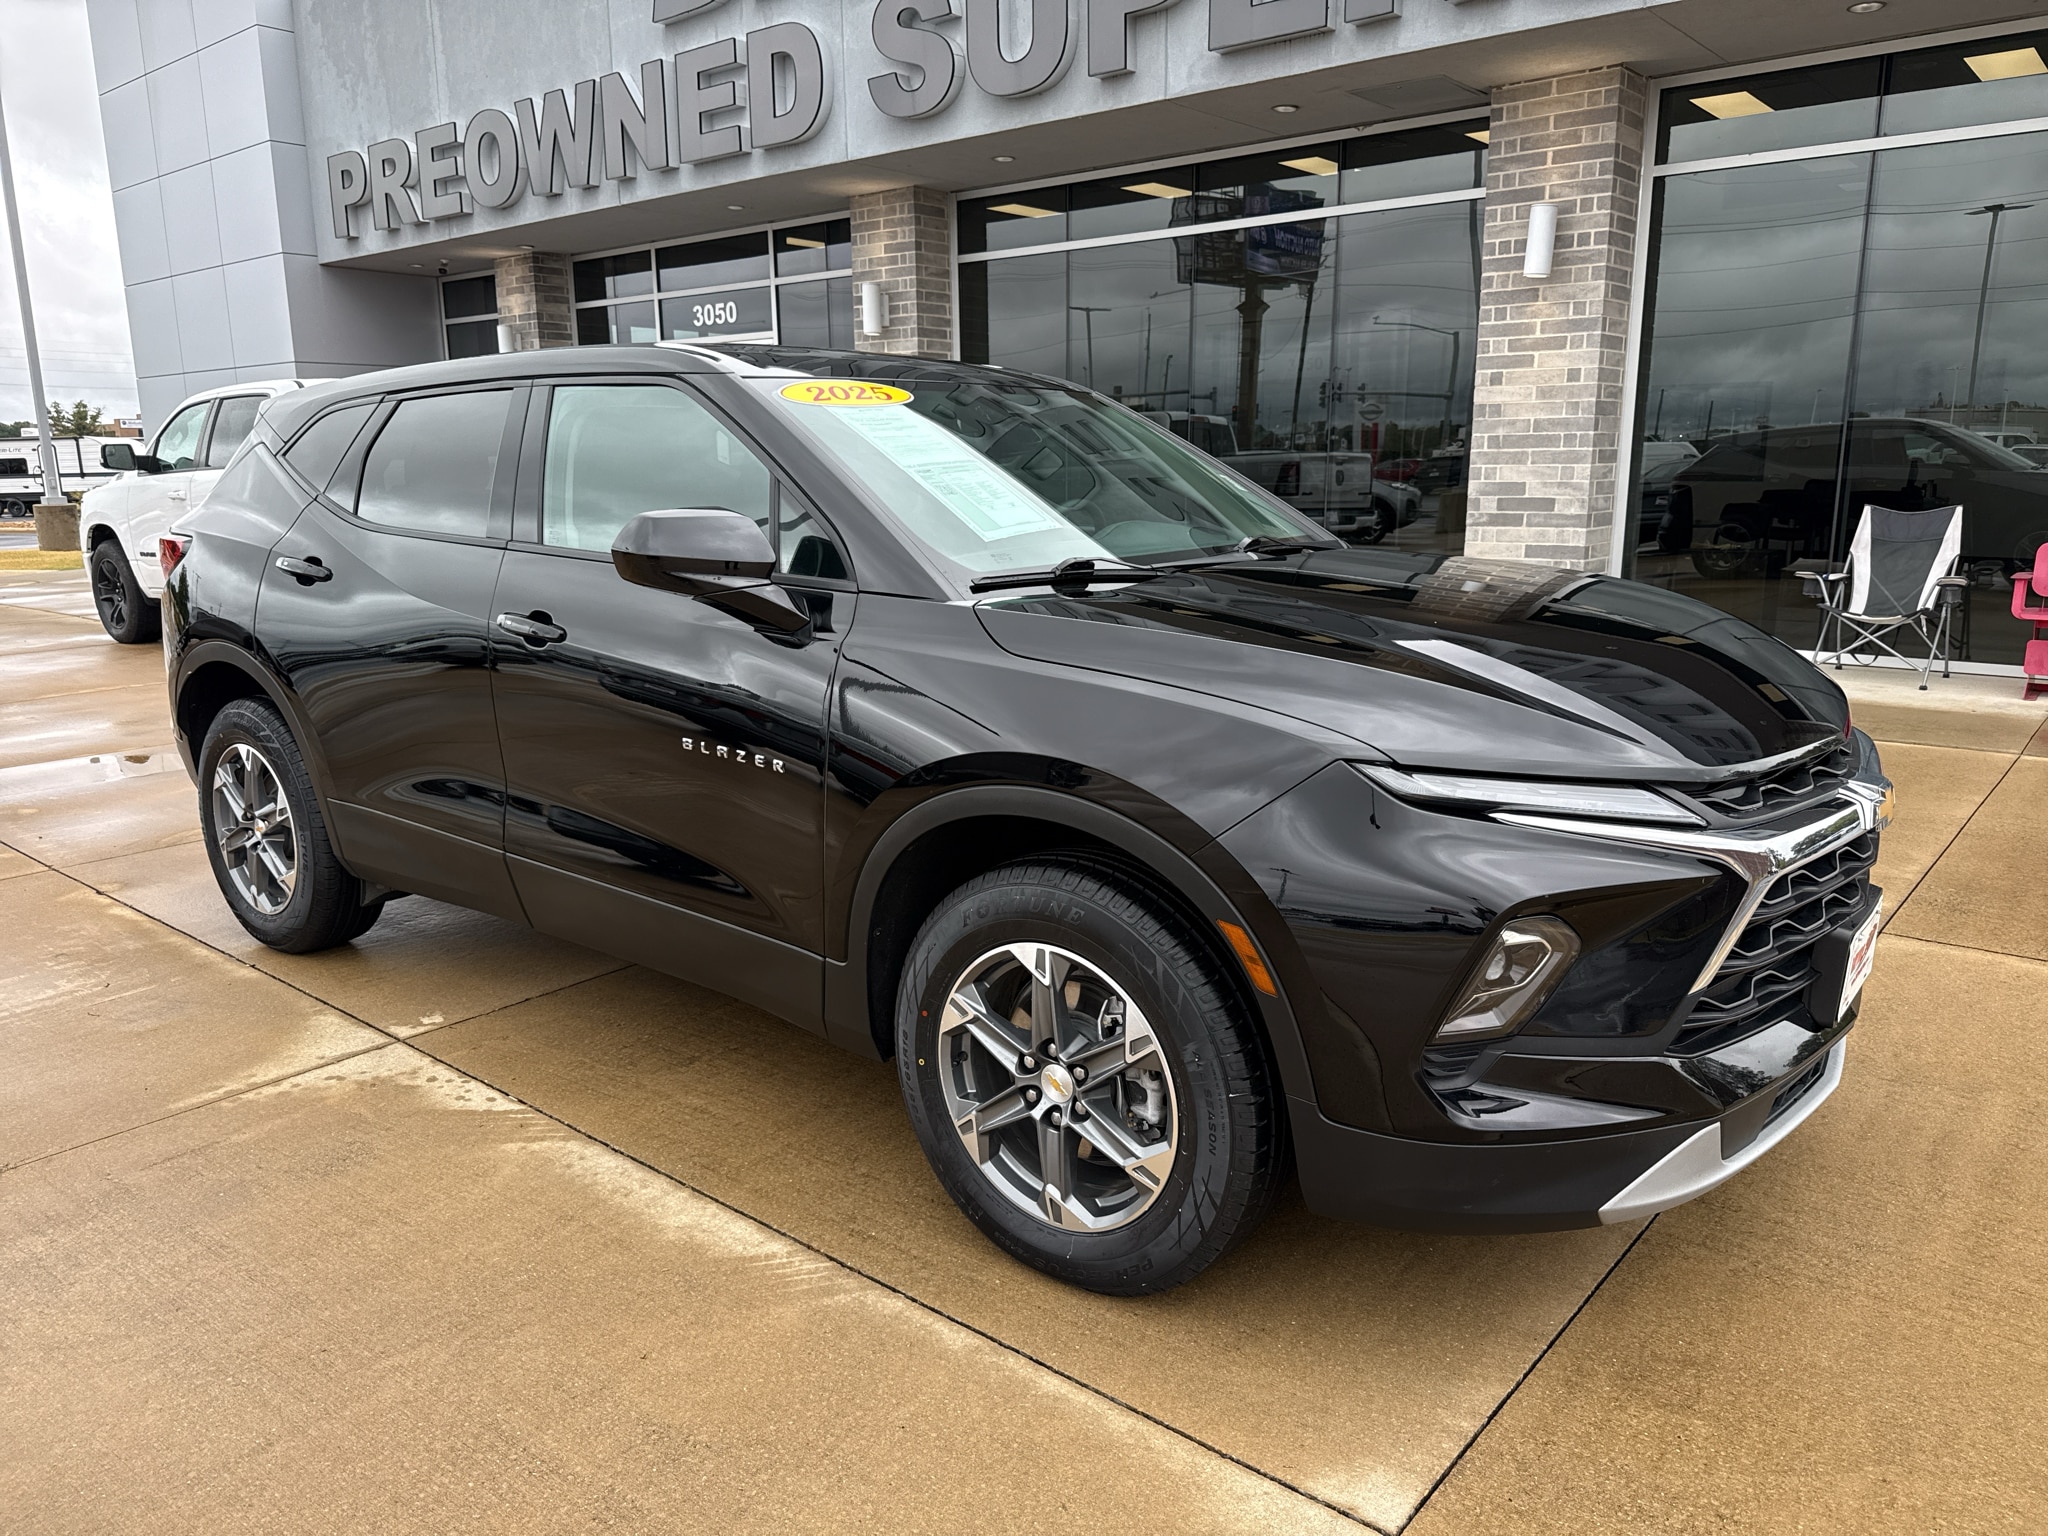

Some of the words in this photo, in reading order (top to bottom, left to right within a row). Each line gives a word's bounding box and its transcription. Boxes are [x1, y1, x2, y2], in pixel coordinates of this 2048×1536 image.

[327, 22, 832, 240] PREOWNED
[692, 301, 737, 327] 3050
[806, 385, 893, 402] 2025
[681, 737, 785, 774] BLAZER
[960, 895, 1086, 928] FORTUNE
[1202, 1087, 1218, 1157] SEASON
